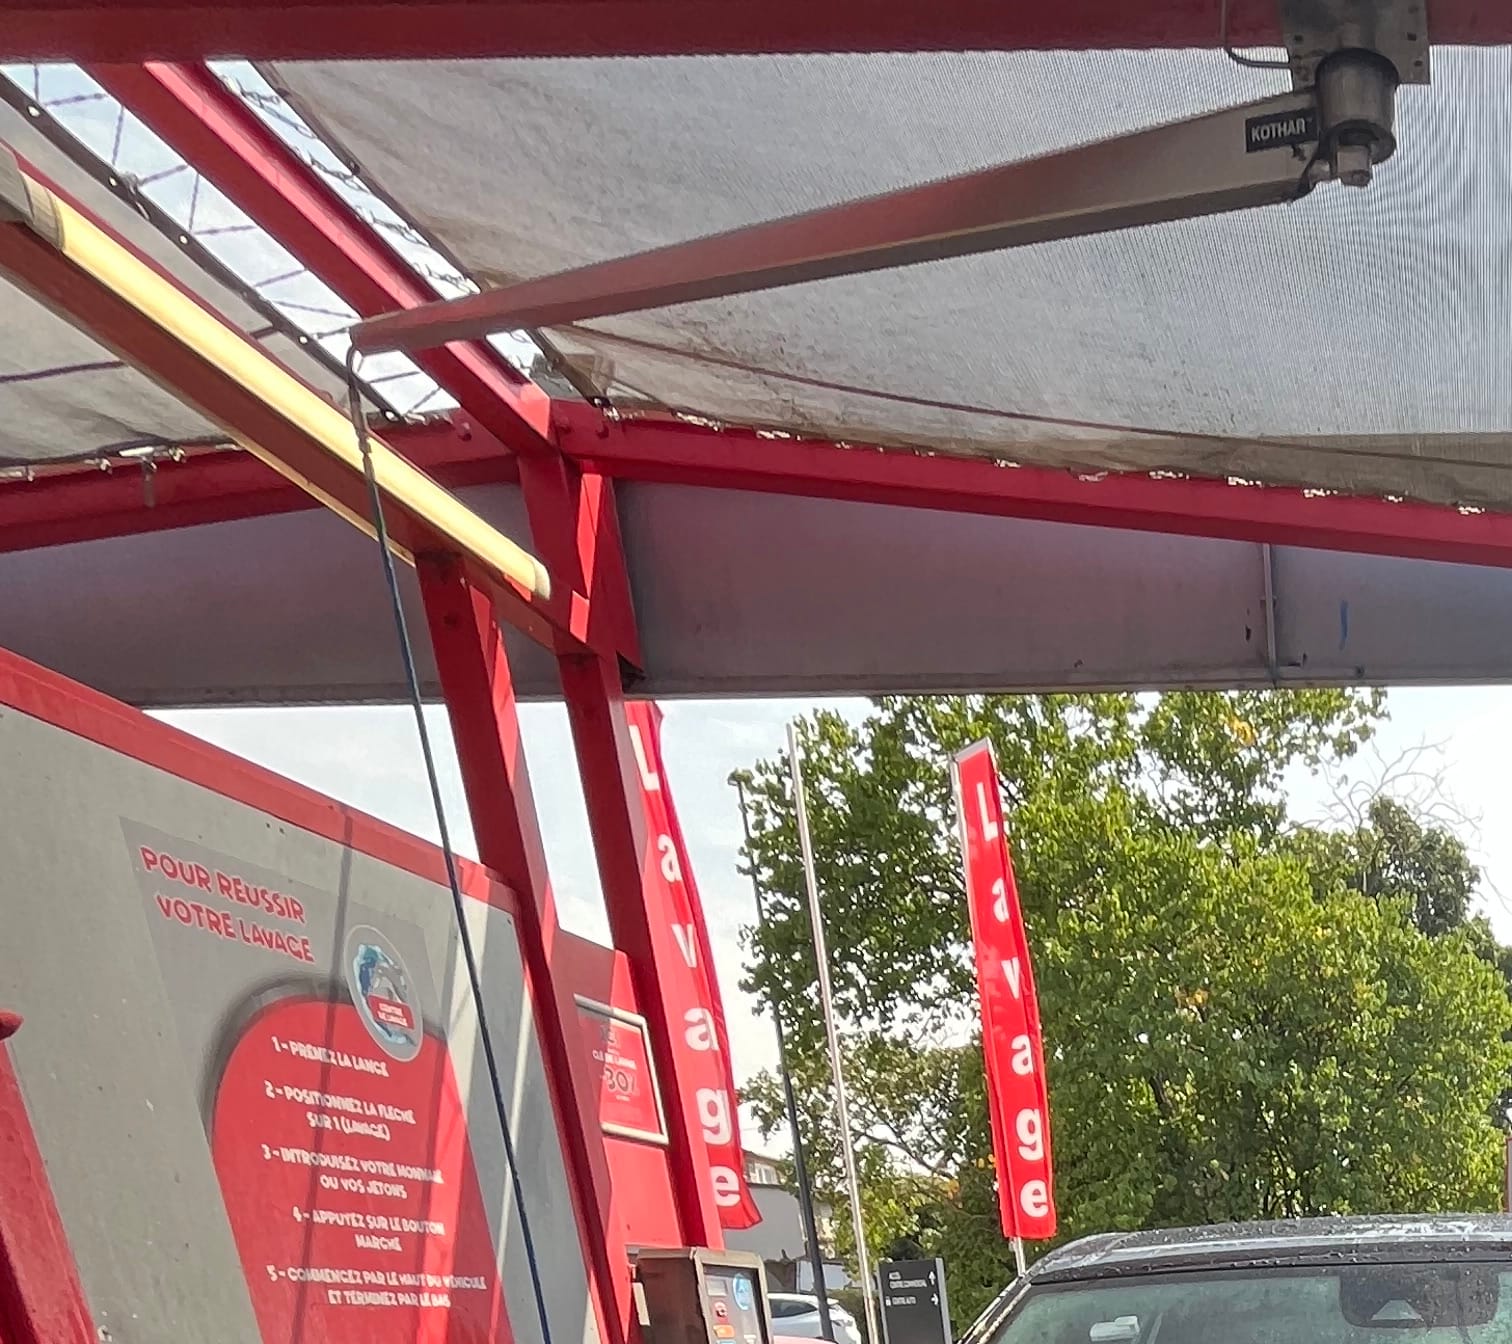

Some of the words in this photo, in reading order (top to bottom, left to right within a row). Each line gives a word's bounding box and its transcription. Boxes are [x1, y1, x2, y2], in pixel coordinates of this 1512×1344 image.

[139, 846, 212, 893] POUR
[156, 894, 237, 939] VOTRE
[238, 919, 315, 962] LAVAGE
[629, 724, 741, 1207] Lavage
[976, 783, 1049, 1217] Lavage
[289, 1040, 336, 1064] PRENEZ
[337, 1051, 352, 1067] LA
[351, 1055, 390, 1077] LANCE
[284, 1085, 363, 1115] POSITIONNEZ
[363, 1101, 378, 1117] LA
[306, 1111, 332, 1130] SUR
[280, 1147, 360, 1171] INTRODUISEZ
[360, 1159, 398, 1177] VOTRE
[320, 1174, 338, 1189] OU
[340, 1177, 365, 1194] VOS
[366, 1181, 407, 1199] JETONS
[312, 1209, 366, 1228] APPUYEZ
[366, 1215, 389, 1230] SUR
[390, 1217, 401, 1231] LE
[287, 1267, 363, 1284] COMMENCEZ
[363, 1270, 386, 1285] PAR
[386, 1271, 400, 1286] LE
[398, 1291, 419, 1306] PAR
